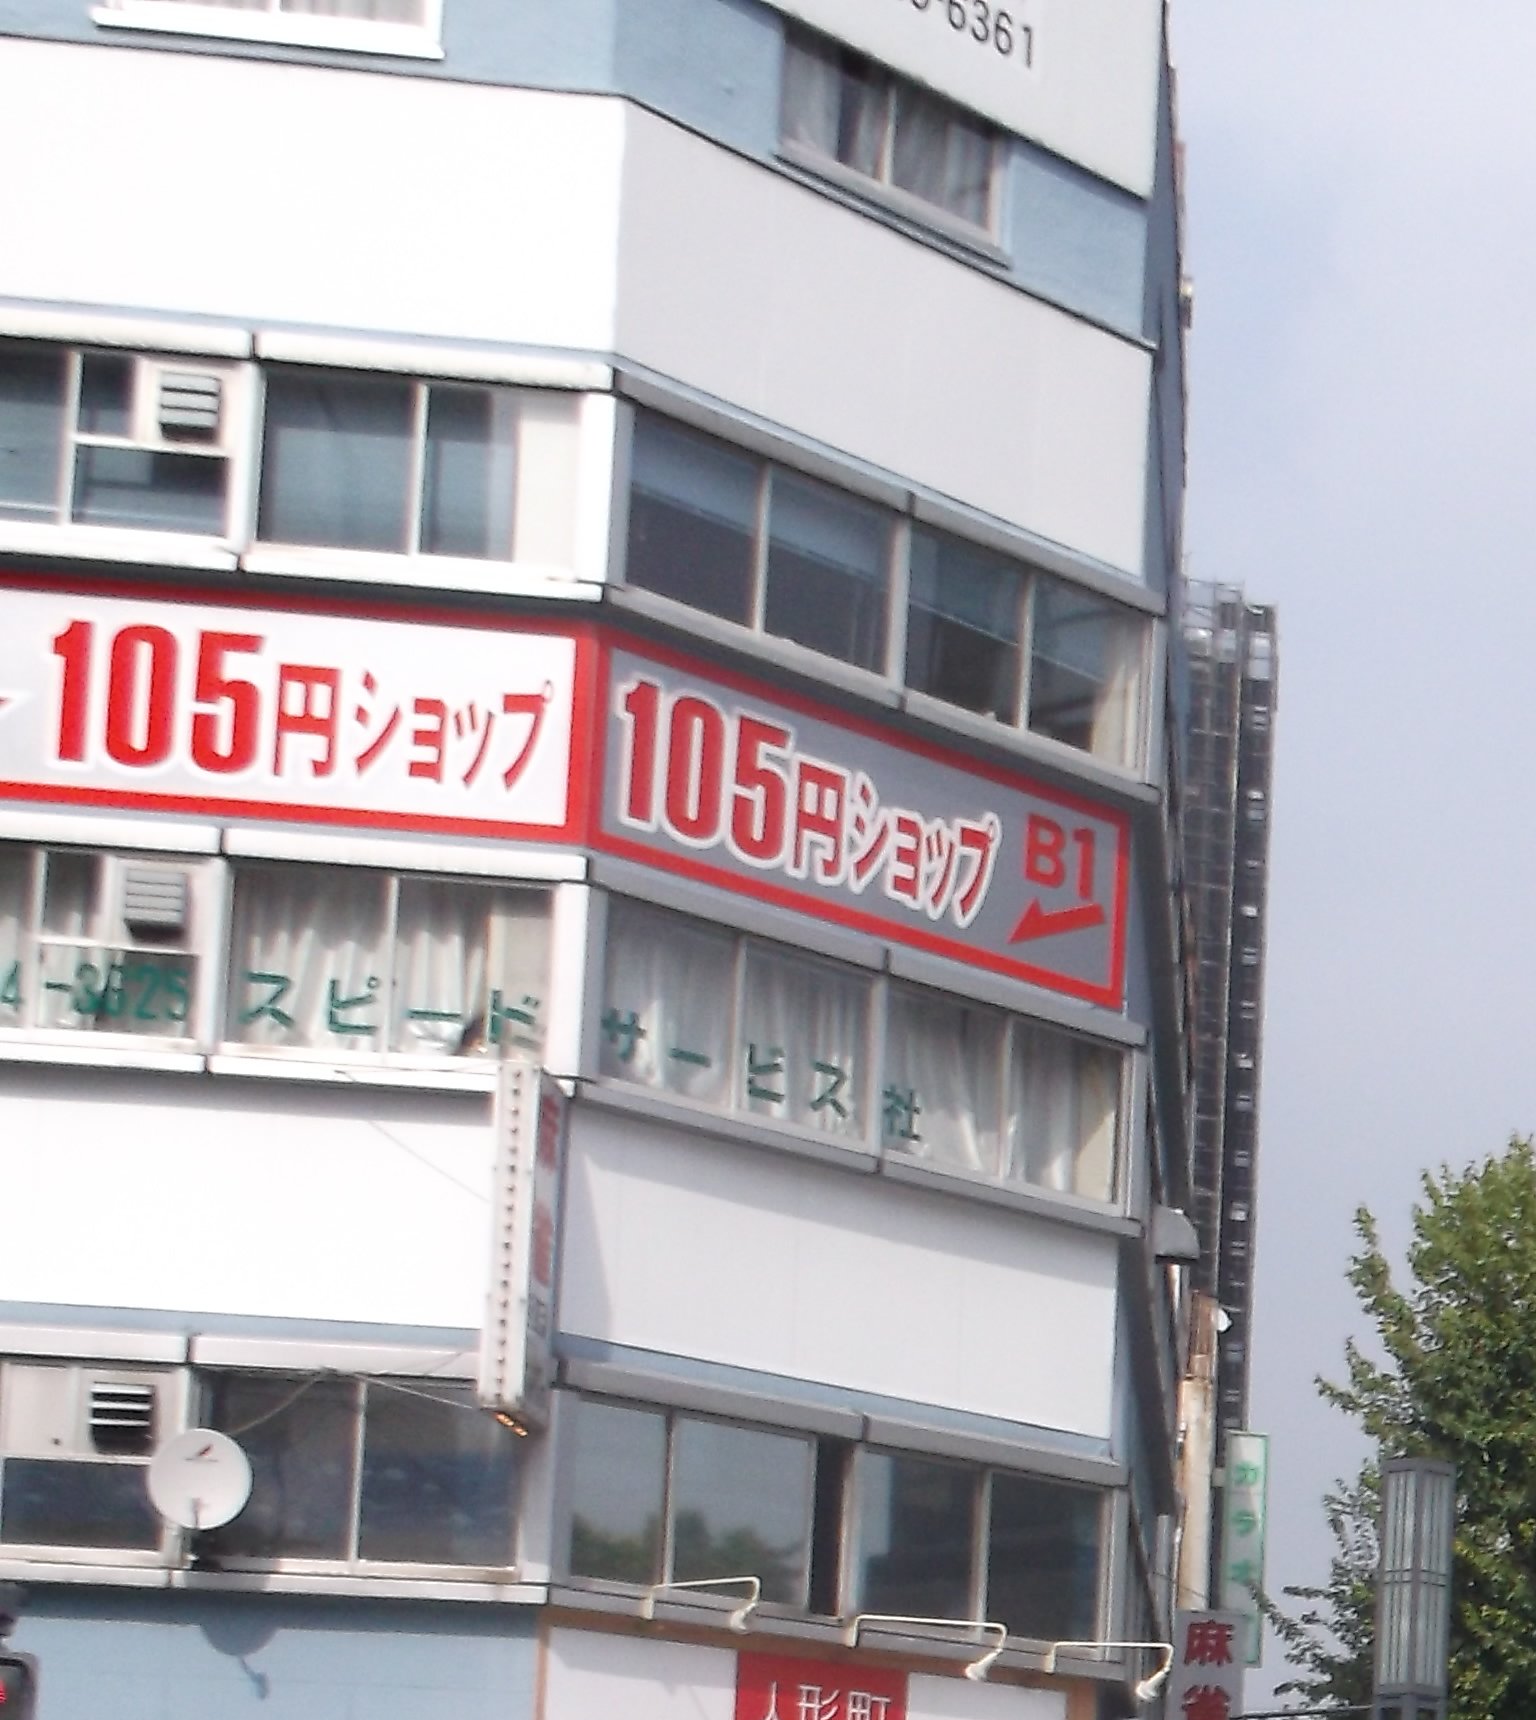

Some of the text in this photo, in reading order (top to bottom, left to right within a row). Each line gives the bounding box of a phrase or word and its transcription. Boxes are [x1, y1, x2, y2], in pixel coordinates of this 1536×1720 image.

[912, 0, 1032, 69] 6361
[52, 620, 555, 790] 105円ショップ
[619, 677, 1096, 926] 105円ショップ B1
[601, 1008, 921, 1140] サービス社
